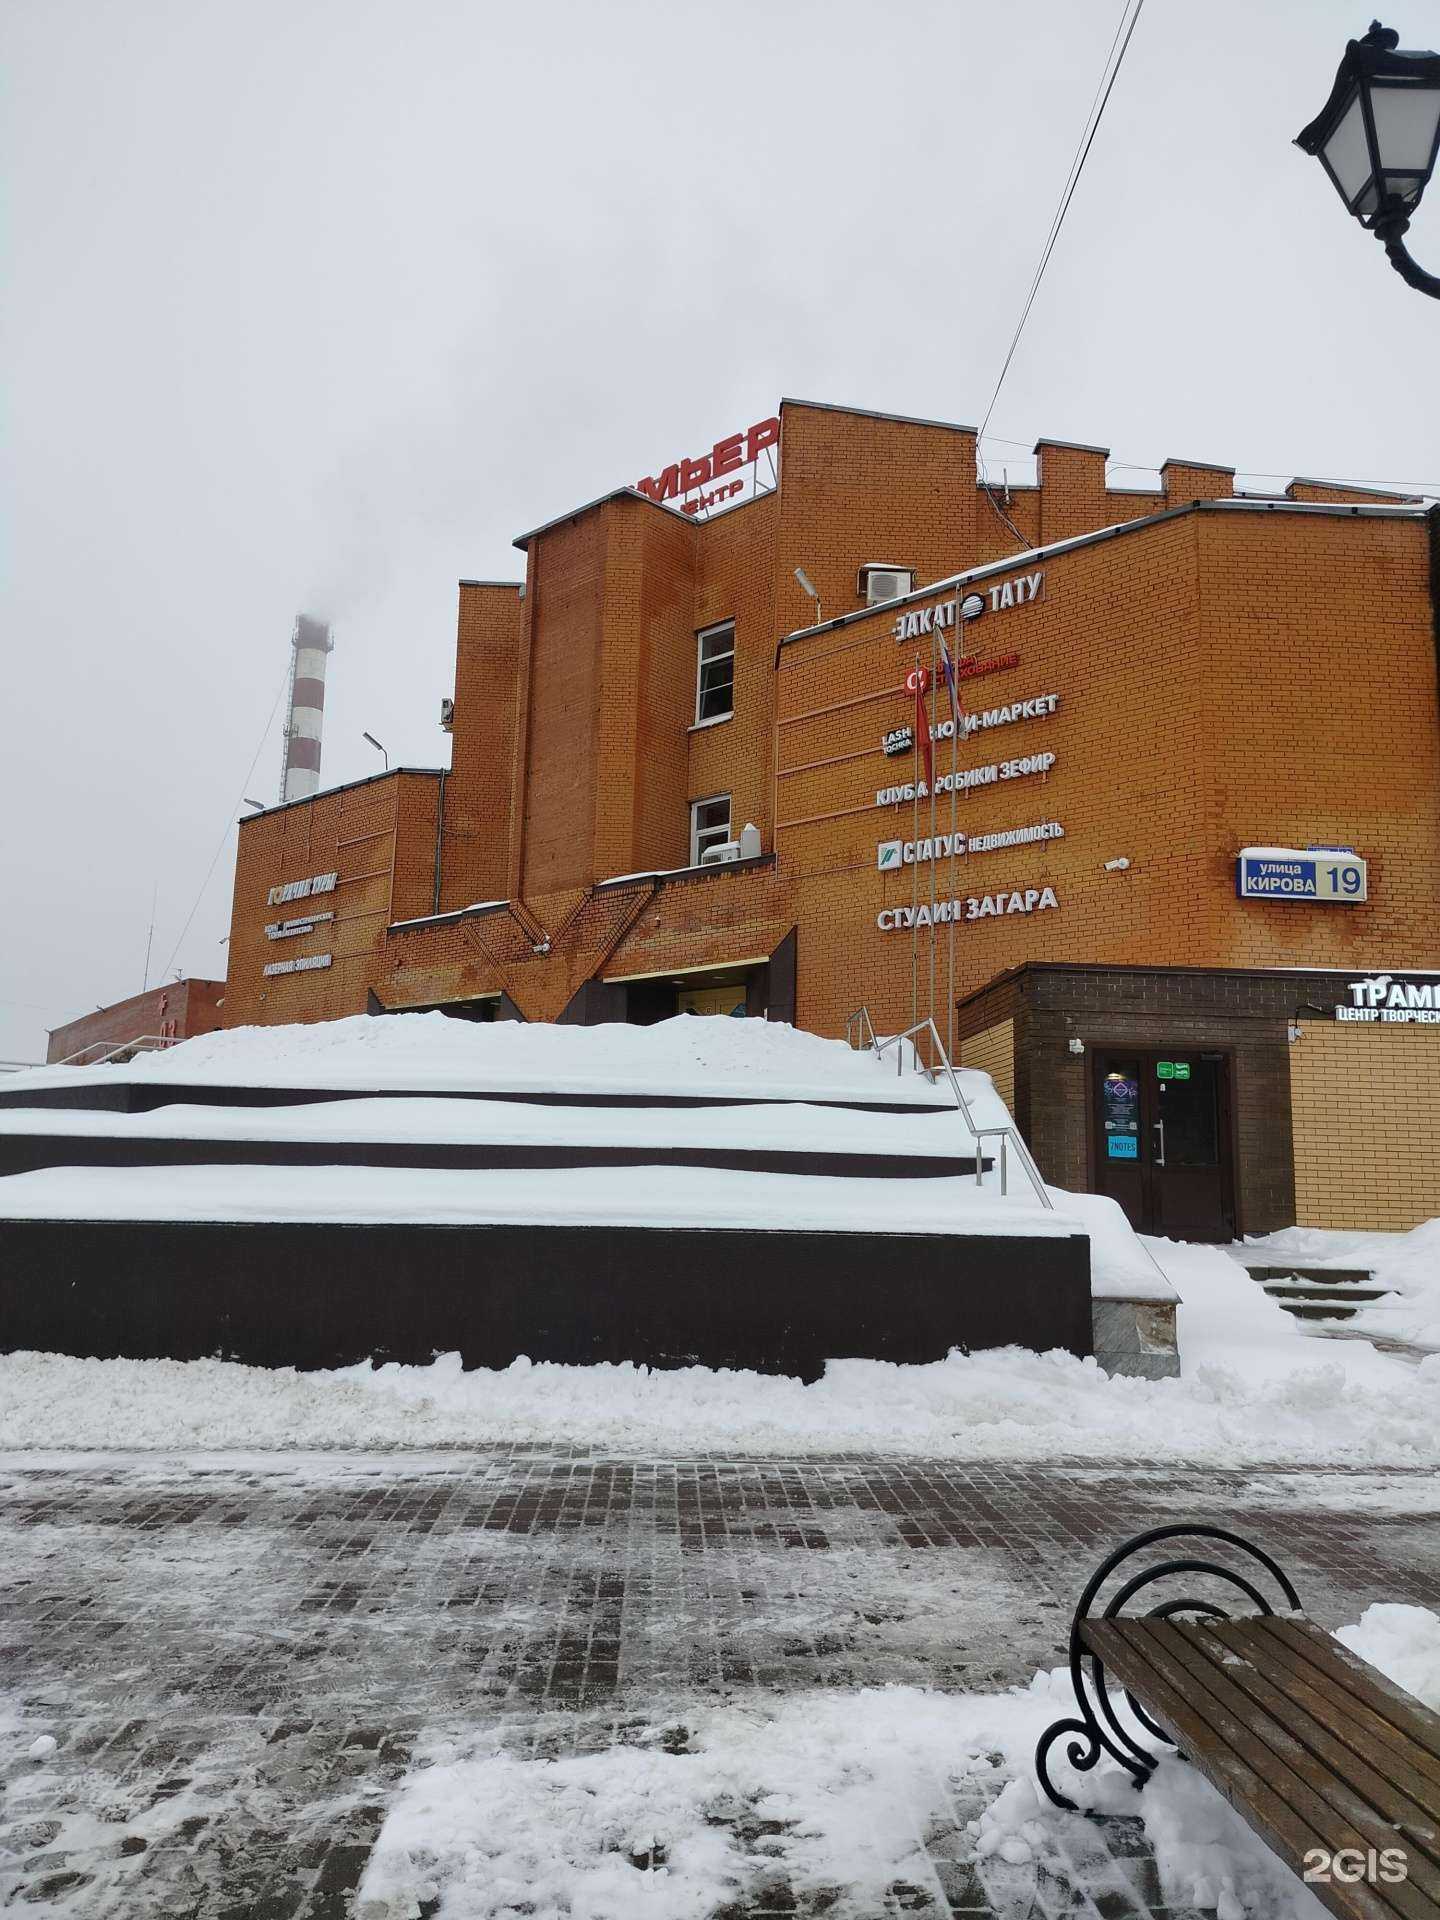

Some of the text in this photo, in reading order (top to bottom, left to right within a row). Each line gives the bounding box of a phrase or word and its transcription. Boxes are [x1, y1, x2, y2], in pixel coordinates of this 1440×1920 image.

[629, 417, 779, 502] МЬЕР
[680, 478, 744, 515] ЕНТР
[894, 572, 1042, 643] ЗАКАТ ТАТУ
[882, 727, 912, 746] LASH
[876, 752, 1056, 806] КЛУБ АРОБИКИ ЗЕФИР
[903, 822, 1065, 864] СТАТУС НЕДВИЖИМОСТЬ
[1246, 876, 1316, 892] КИРОВА
[1259, 863, 1302, 875] улица
[1326, 867, 1361, 894] 19
[877, 887, 1059, 931] СТУДИЯ ЗАГАРА
[1337, 1007, 1379, 1021] ЦЕНТР
